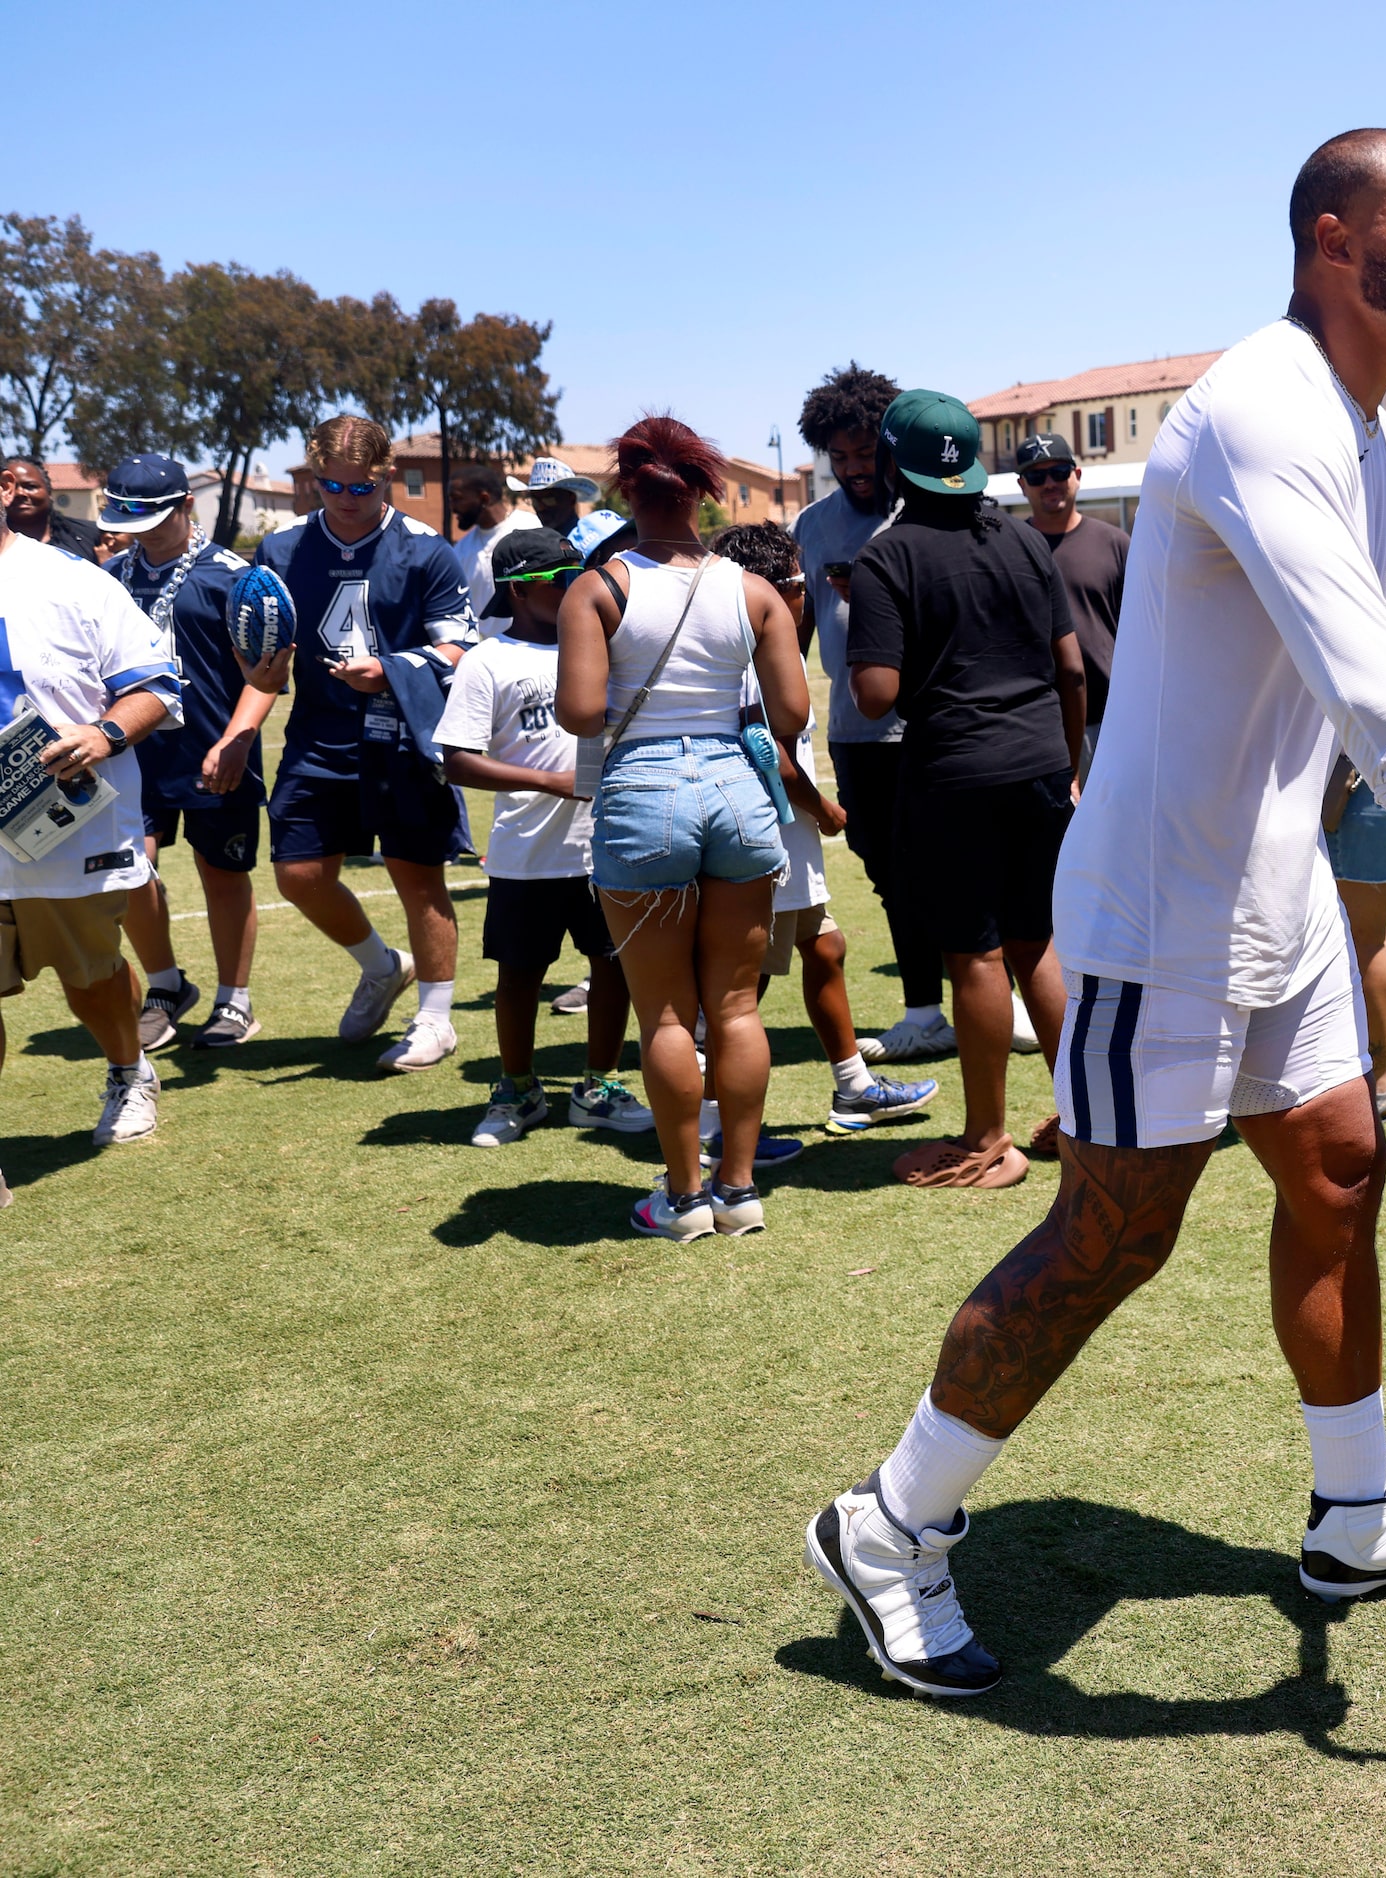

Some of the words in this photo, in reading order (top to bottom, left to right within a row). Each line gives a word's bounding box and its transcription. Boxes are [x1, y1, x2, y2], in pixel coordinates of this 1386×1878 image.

[940, 435, 959, 463] LA
[262, 596, 279, 655] OWBOYS
[317, 579, 380, 658] 4
[516, 674, 557, 704] DA
[8, 728, 48, 768] OFF
[11, 771, 35, 796] DALLAS
[0, 785, 33, 818] GAME
